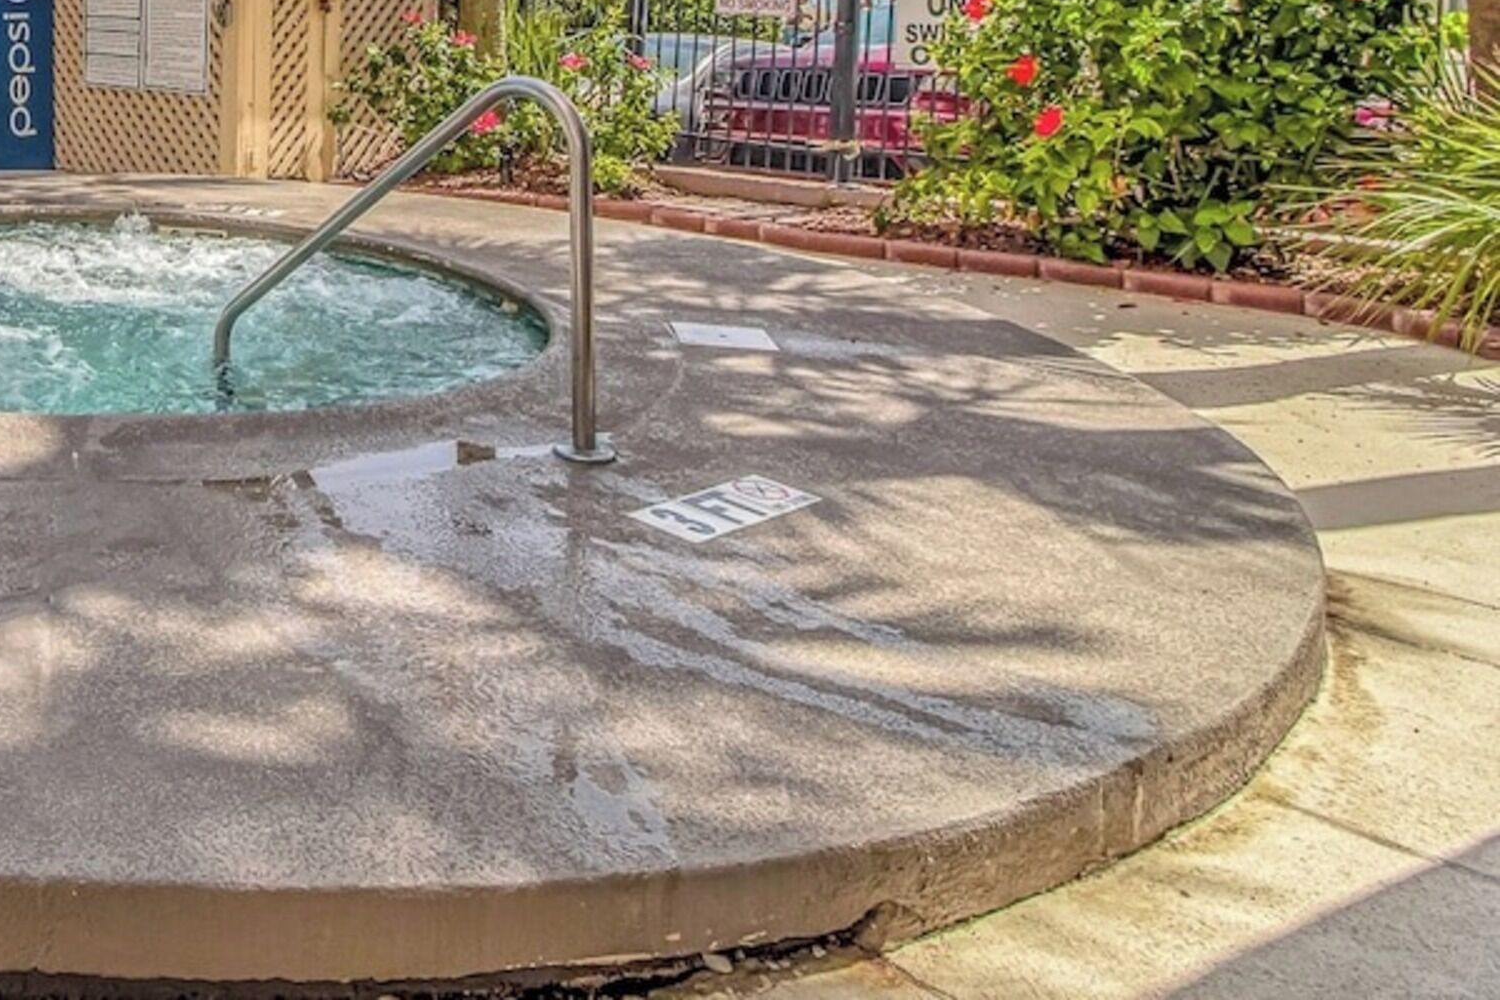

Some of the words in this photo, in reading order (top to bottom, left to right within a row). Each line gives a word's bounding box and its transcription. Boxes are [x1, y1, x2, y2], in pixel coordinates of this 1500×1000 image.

[905, 23, 945, 43] SWI
[3, 11, 37, 137] pepsi
[651, 508, 717, 536] 3
[681, 490, 768, 525] FT
